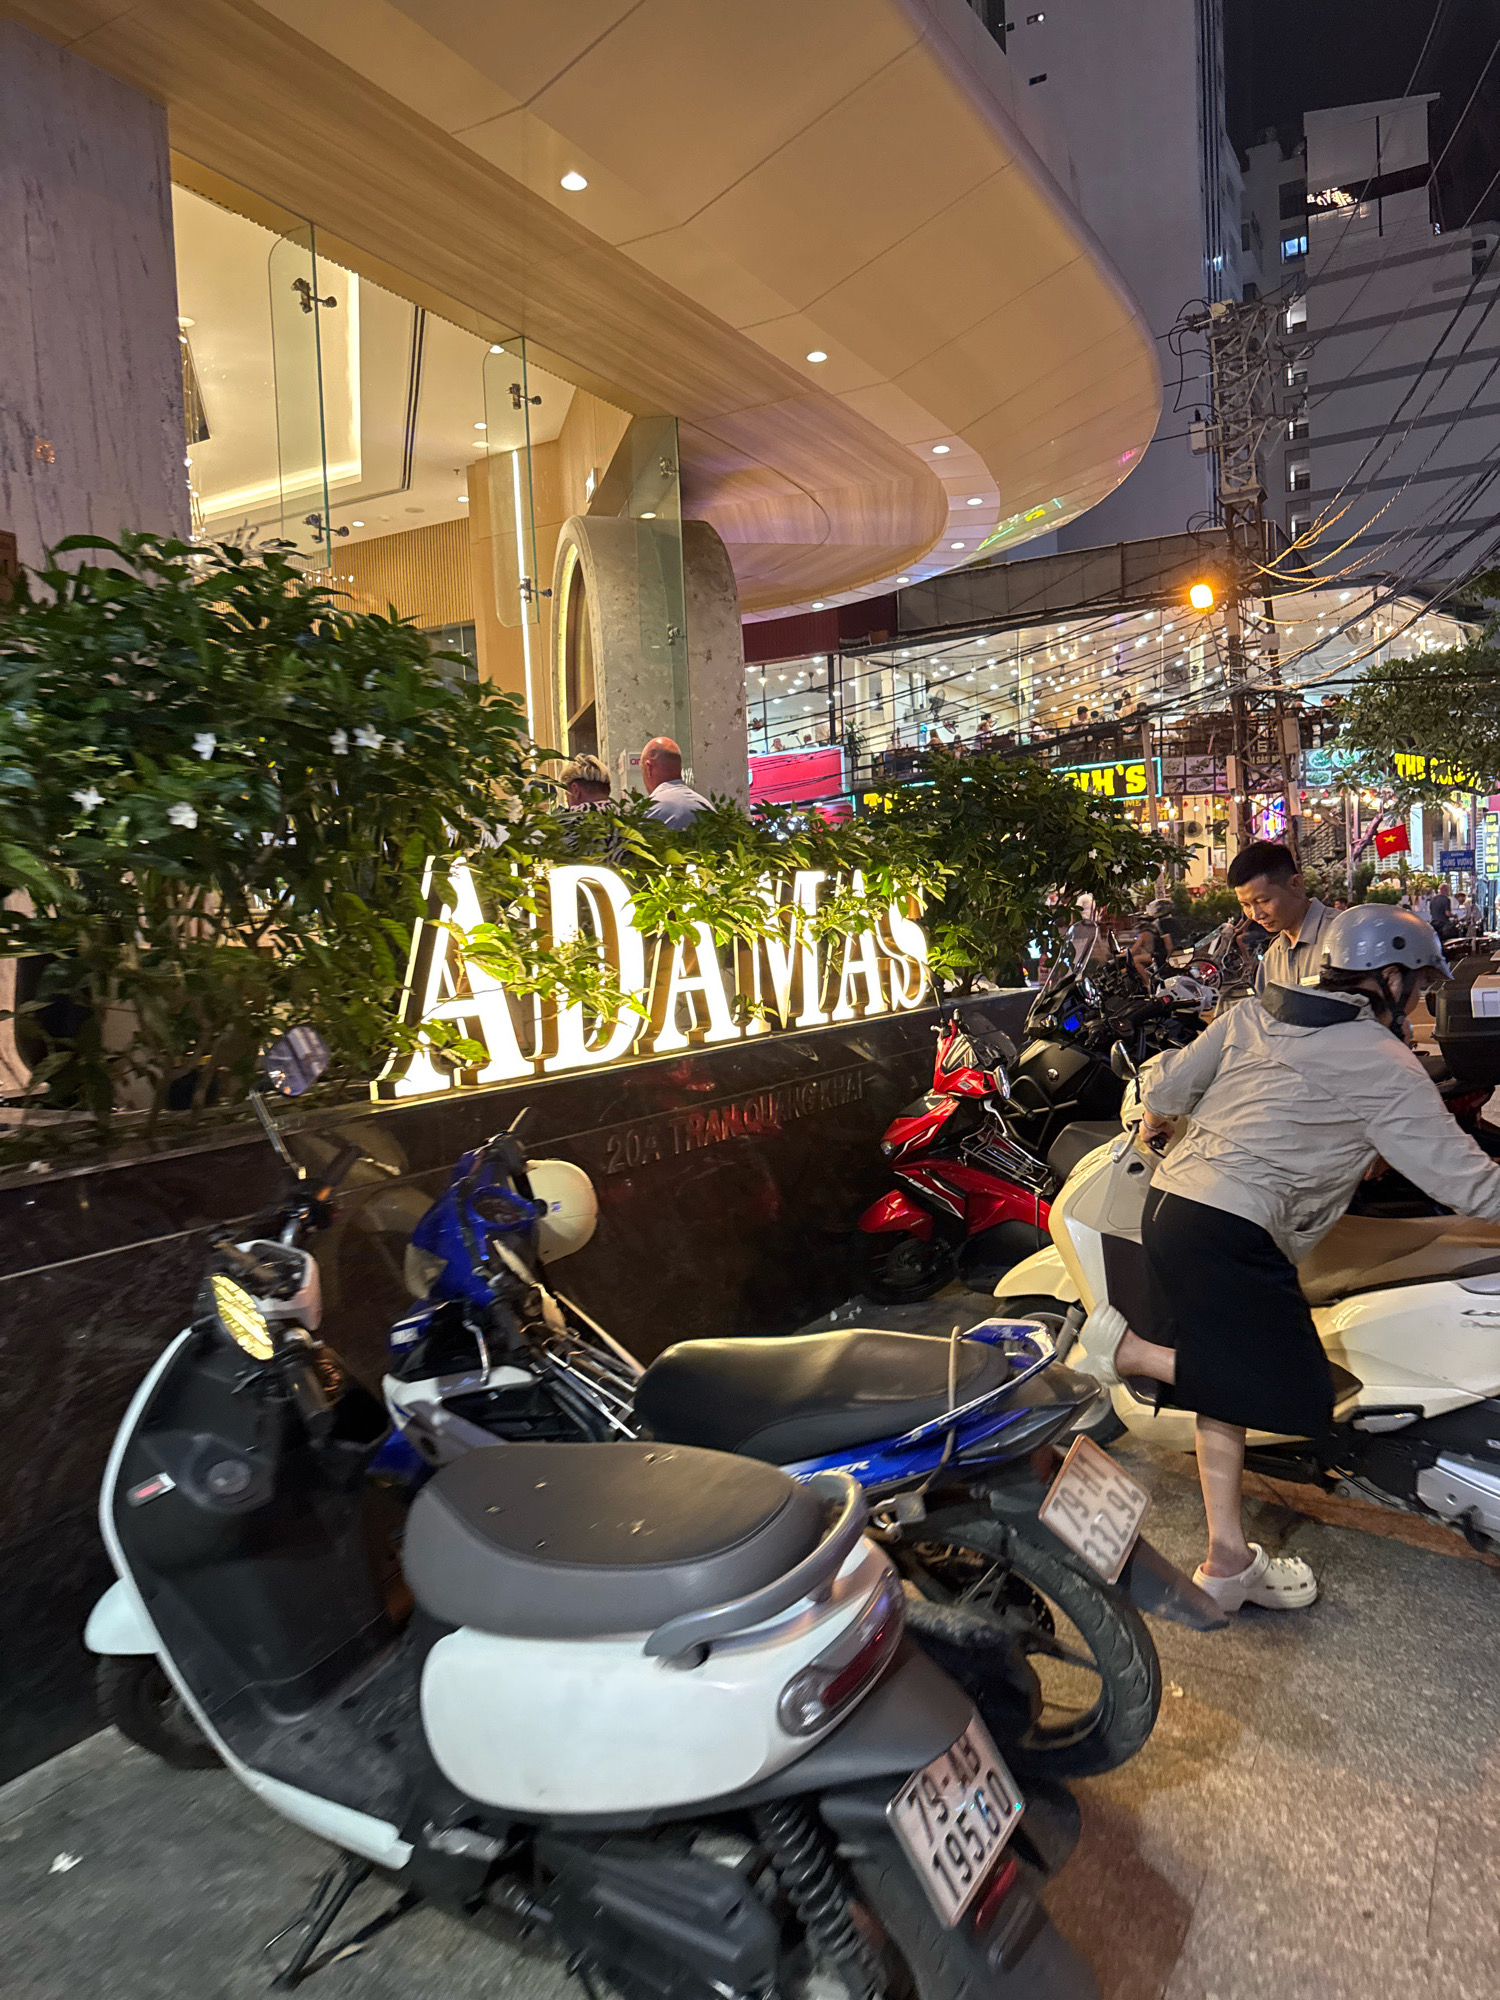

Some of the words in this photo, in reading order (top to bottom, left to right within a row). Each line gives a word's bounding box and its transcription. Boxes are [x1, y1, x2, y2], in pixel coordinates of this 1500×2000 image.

[372, 855, 931, 1098] ADAMAS
[1051, 1453, 1108, 1535] 79-H1
[905, 1734, 981, 1847] 79-AB
[931, 1767, 1012, 1904] 195.60
